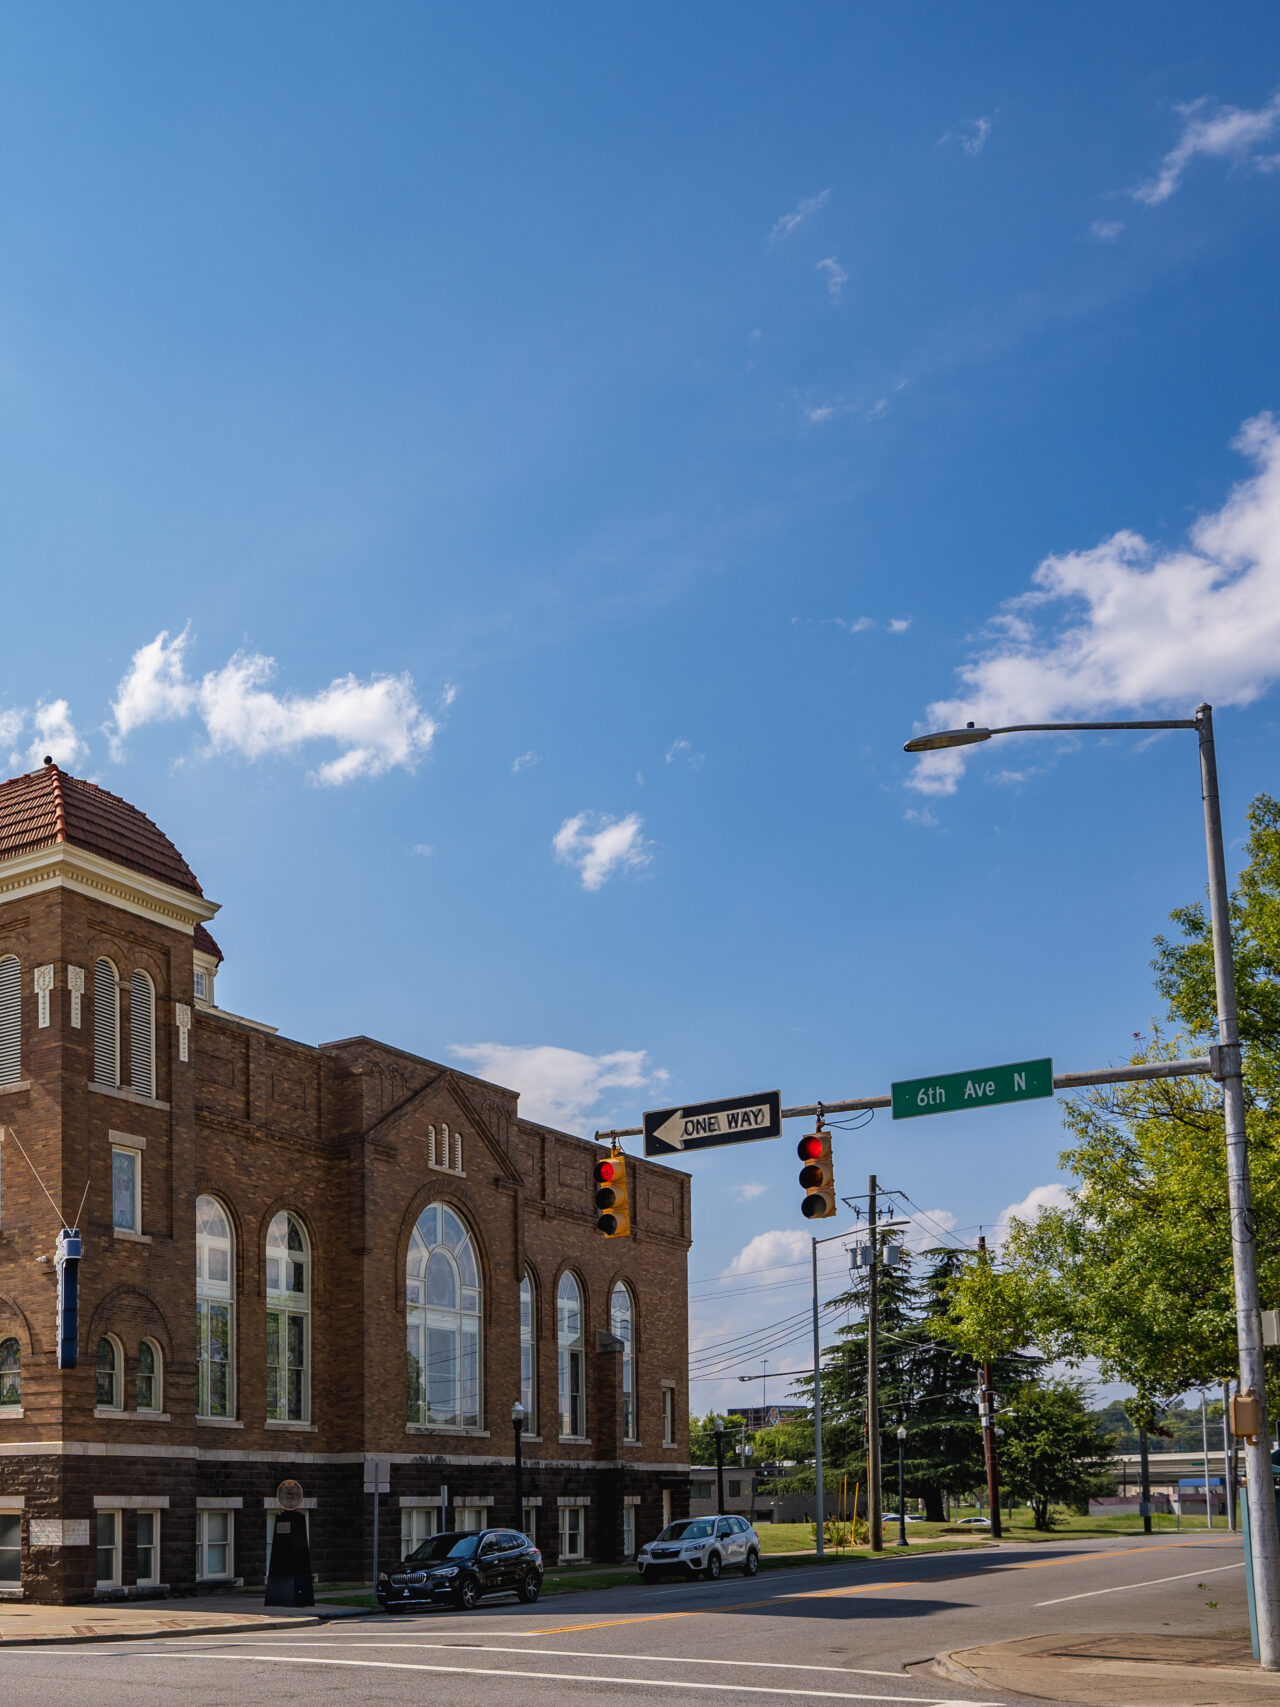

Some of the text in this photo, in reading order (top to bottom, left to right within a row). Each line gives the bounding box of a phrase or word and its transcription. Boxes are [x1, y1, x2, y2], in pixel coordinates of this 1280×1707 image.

[917, 1072, 1026, 1106] 6th Ave N
[684, 1108, 762, 1136] ONE WAY
